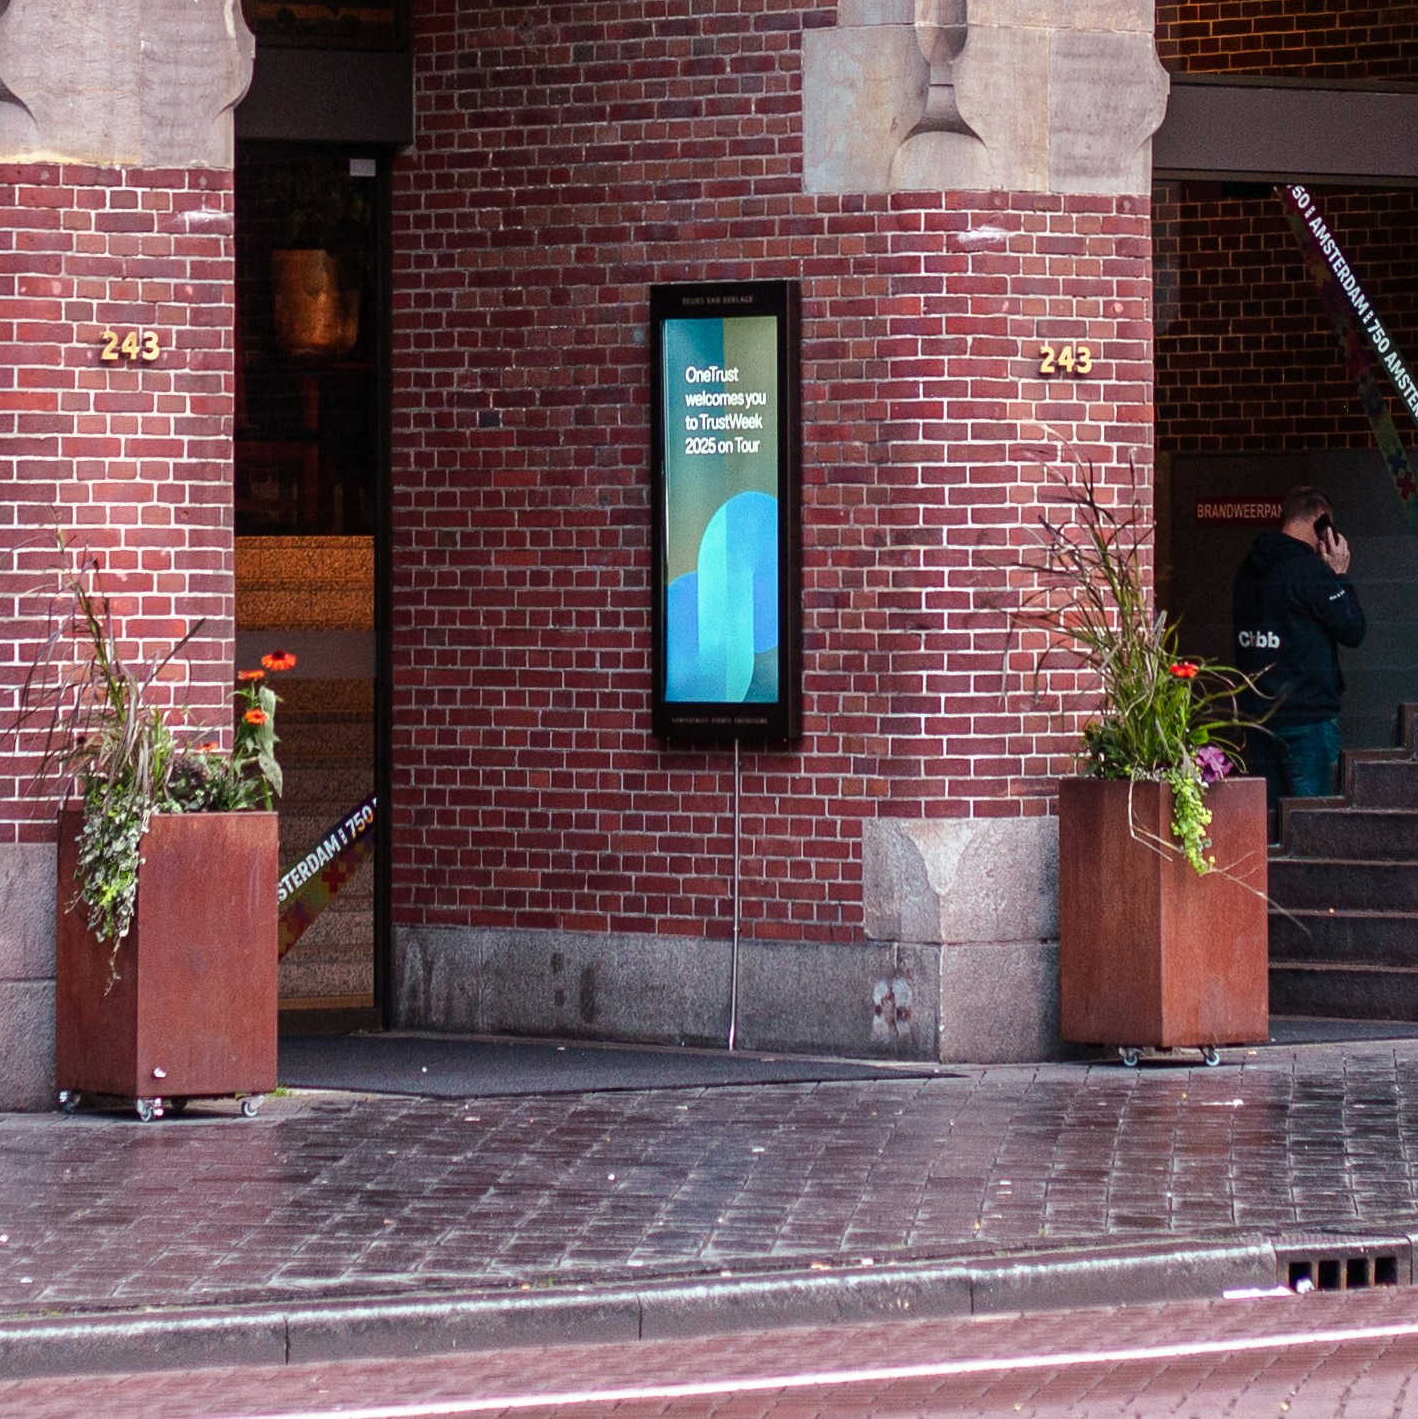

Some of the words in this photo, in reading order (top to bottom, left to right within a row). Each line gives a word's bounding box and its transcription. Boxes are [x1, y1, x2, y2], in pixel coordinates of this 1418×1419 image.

[1287, 185, 1310, 209] 50
[1308, 216, 1370, 316] AMSTERDAM
[1367, 319, 1390, 353] 750
[101, 331, 160, 361] 243
[1039, 346, 1092, 374] 243
[685, 366, 739, 383] OneTrust
[685, 390, 744, 406] welcomes
[745, 392, 766, 409] you
[685, 415, 698, 430] to
[699, 413, 763, 430] TrustWeek
[685, 437, 716, 454] 2025
[718, 440, 733, 453] on
[735, 437, 760, 453] Tour
[345, 805, 373, 838] 750
